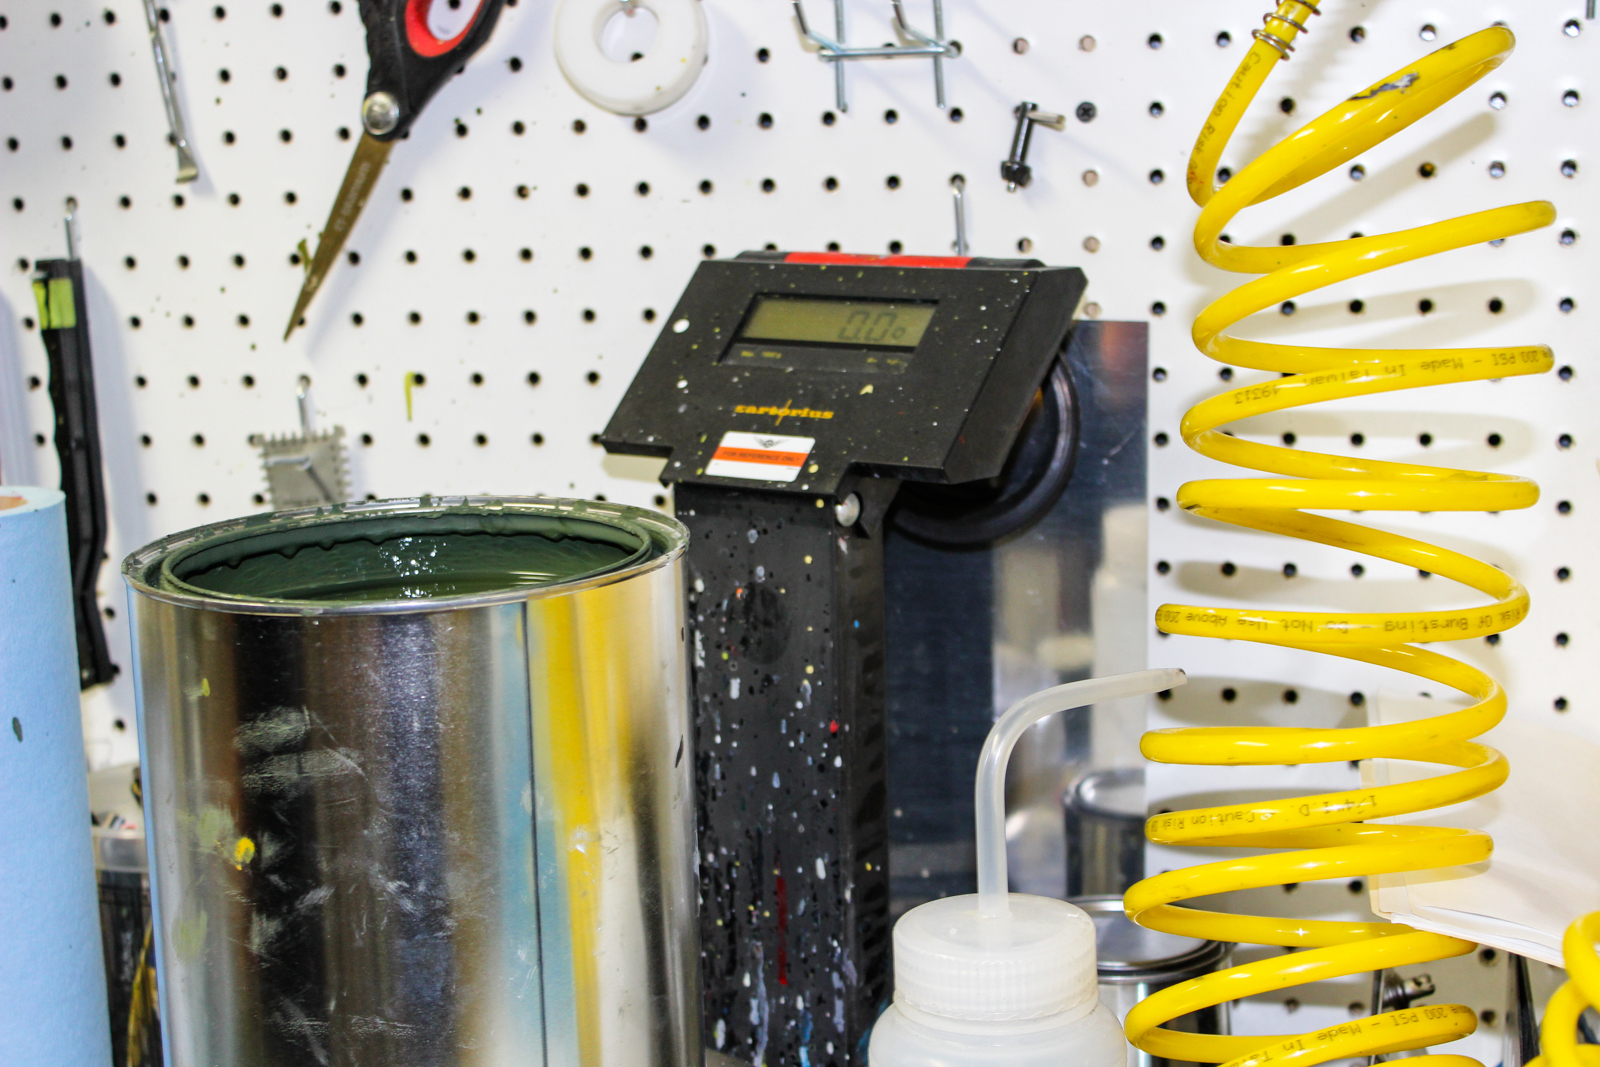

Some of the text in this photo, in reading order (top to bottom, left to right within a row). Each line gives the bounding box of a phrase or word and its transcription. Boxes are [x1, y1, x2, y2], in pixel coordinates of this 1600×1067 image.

[1212, 52, 1261, 118] Caution
[1420, 356, 1464, 373] Made
[1491, 352, 1515, 366] PSI
[1384, 364, 1406, 377] In
[734, 402, 834, 423] sartorius
[1186, 611, 1228, 627] Above
[1237, 617, 1268, 632] Use
[1384, 617, 1468, 634] Bursting
[1498, 608, 1521, 627] Risk
[1281, 619, 1313, 633] Not
[1326, 620, 1349, 634] Do
[1161, 817, 1185, 831] Risk
[1191, 810, 1255, 826] Caution
[1389, 1011, 1419, 1028] PSI
[1423, 1006, 1448, 1021] 200
[1316, 1022, 1362, 1042] Made
[1282, 1039, 1305, 1053] In
